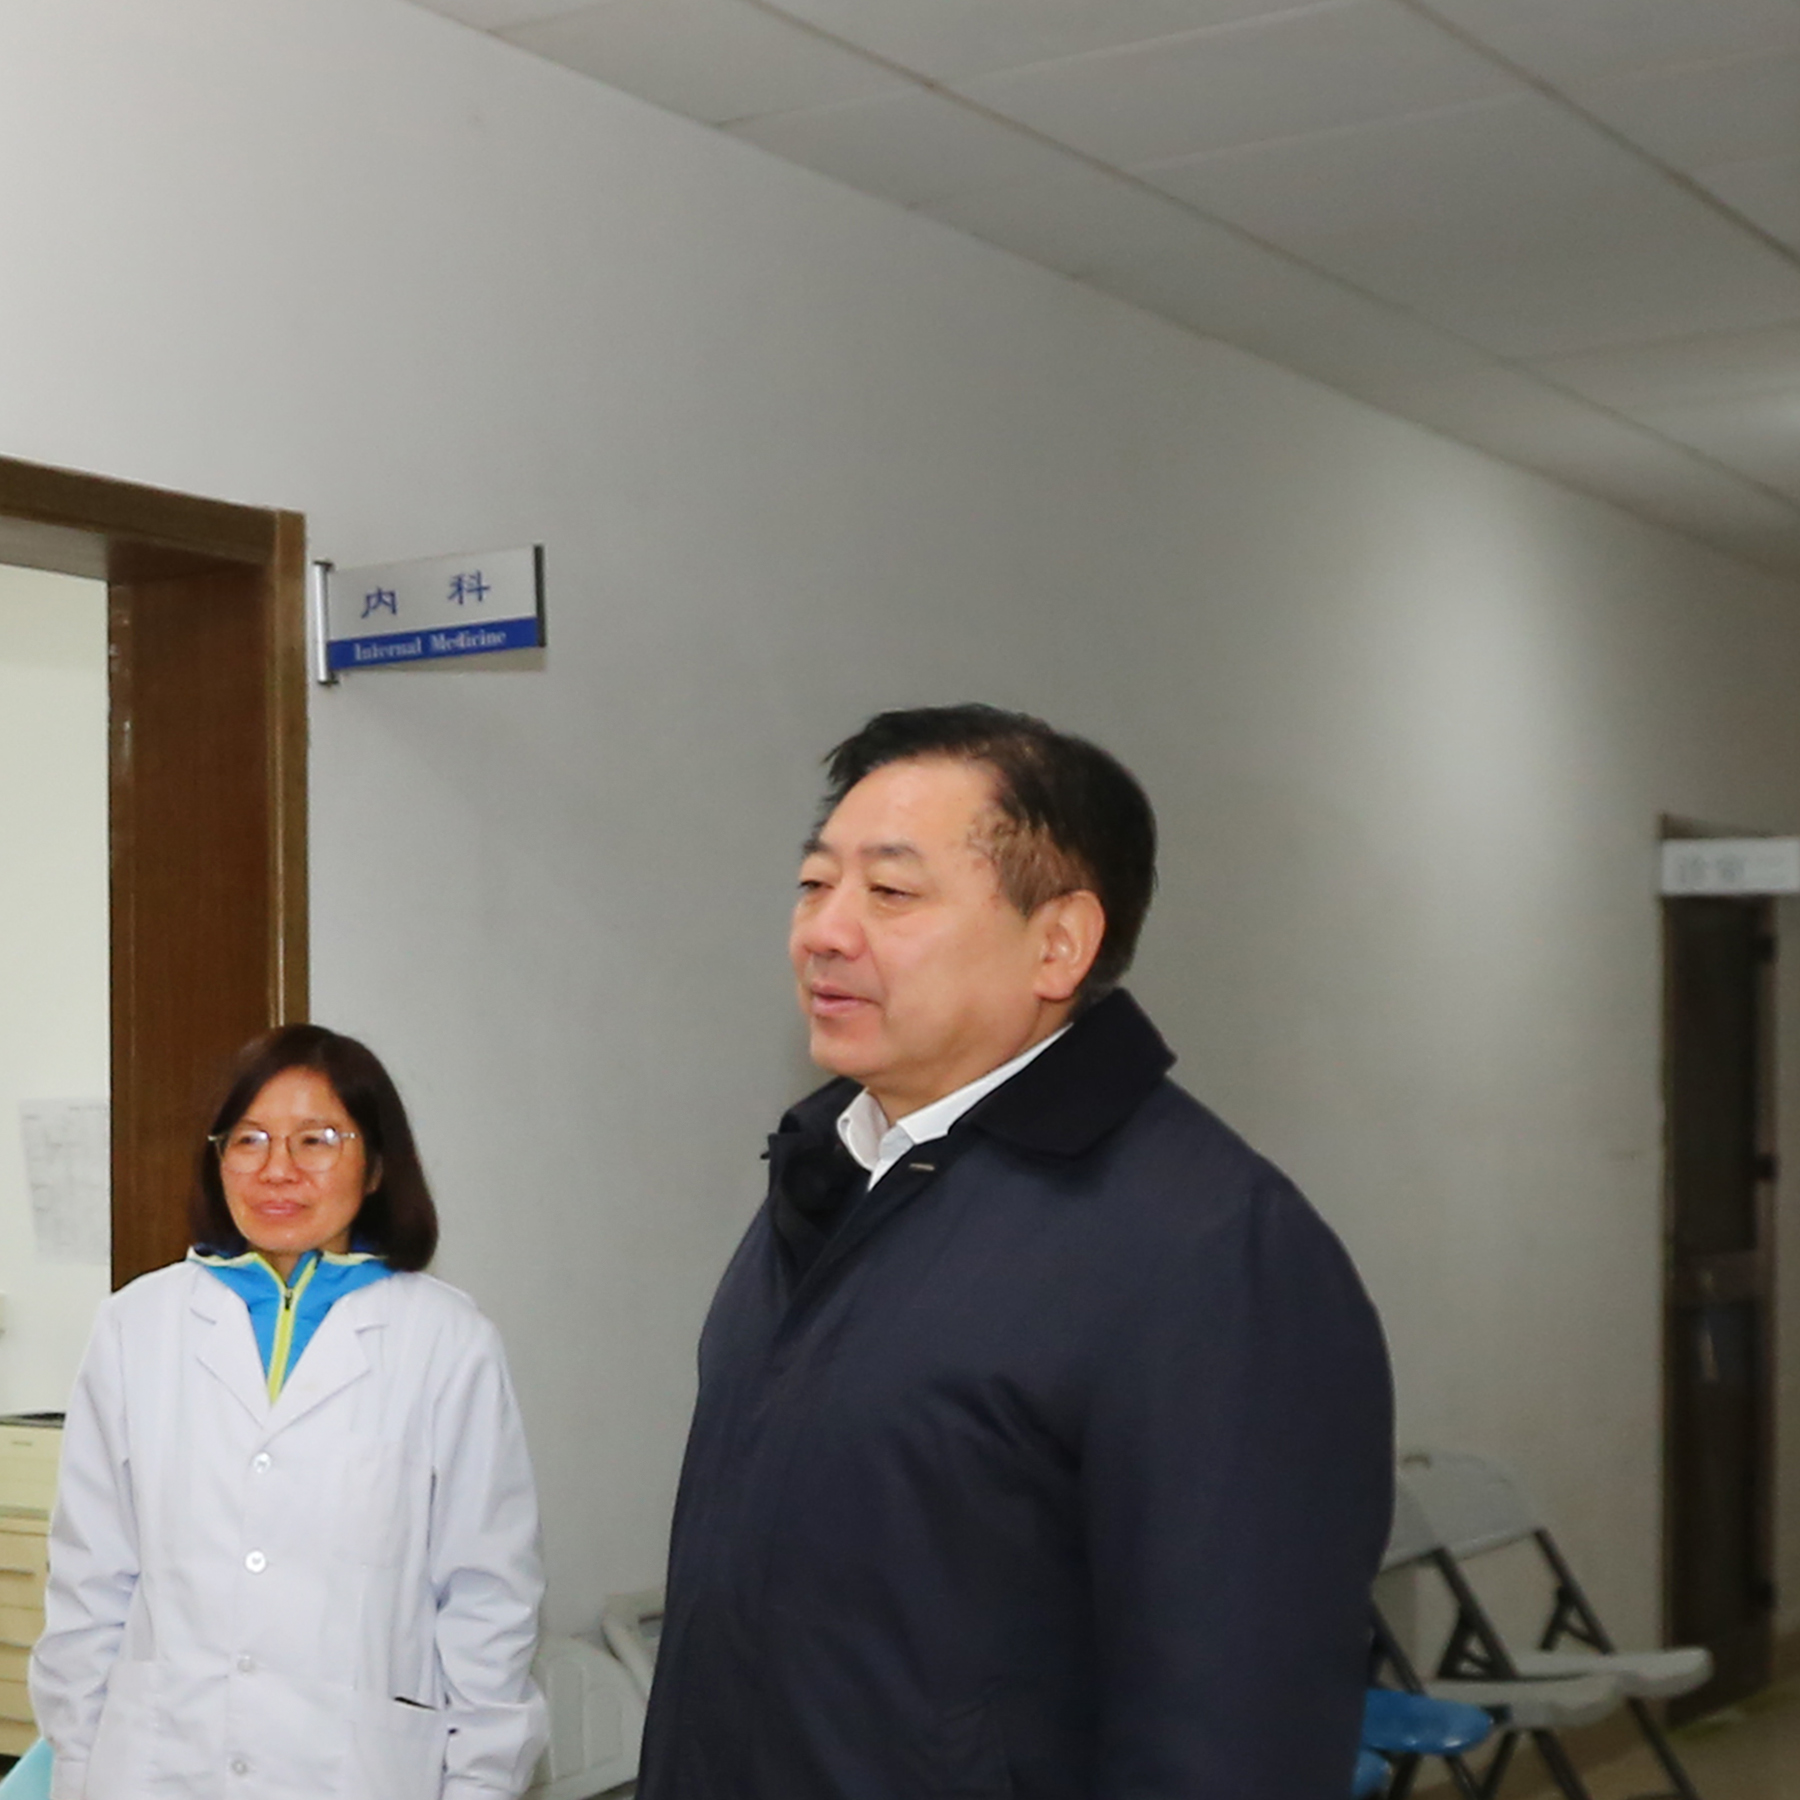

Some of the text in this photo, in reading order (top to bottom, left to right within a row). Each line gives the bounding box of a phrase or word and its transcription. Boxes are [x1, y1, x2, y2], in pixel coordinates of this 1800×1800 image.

[360, 569, 491, 619] 内科
[354, 629, 507, 661] Internal Medicine
